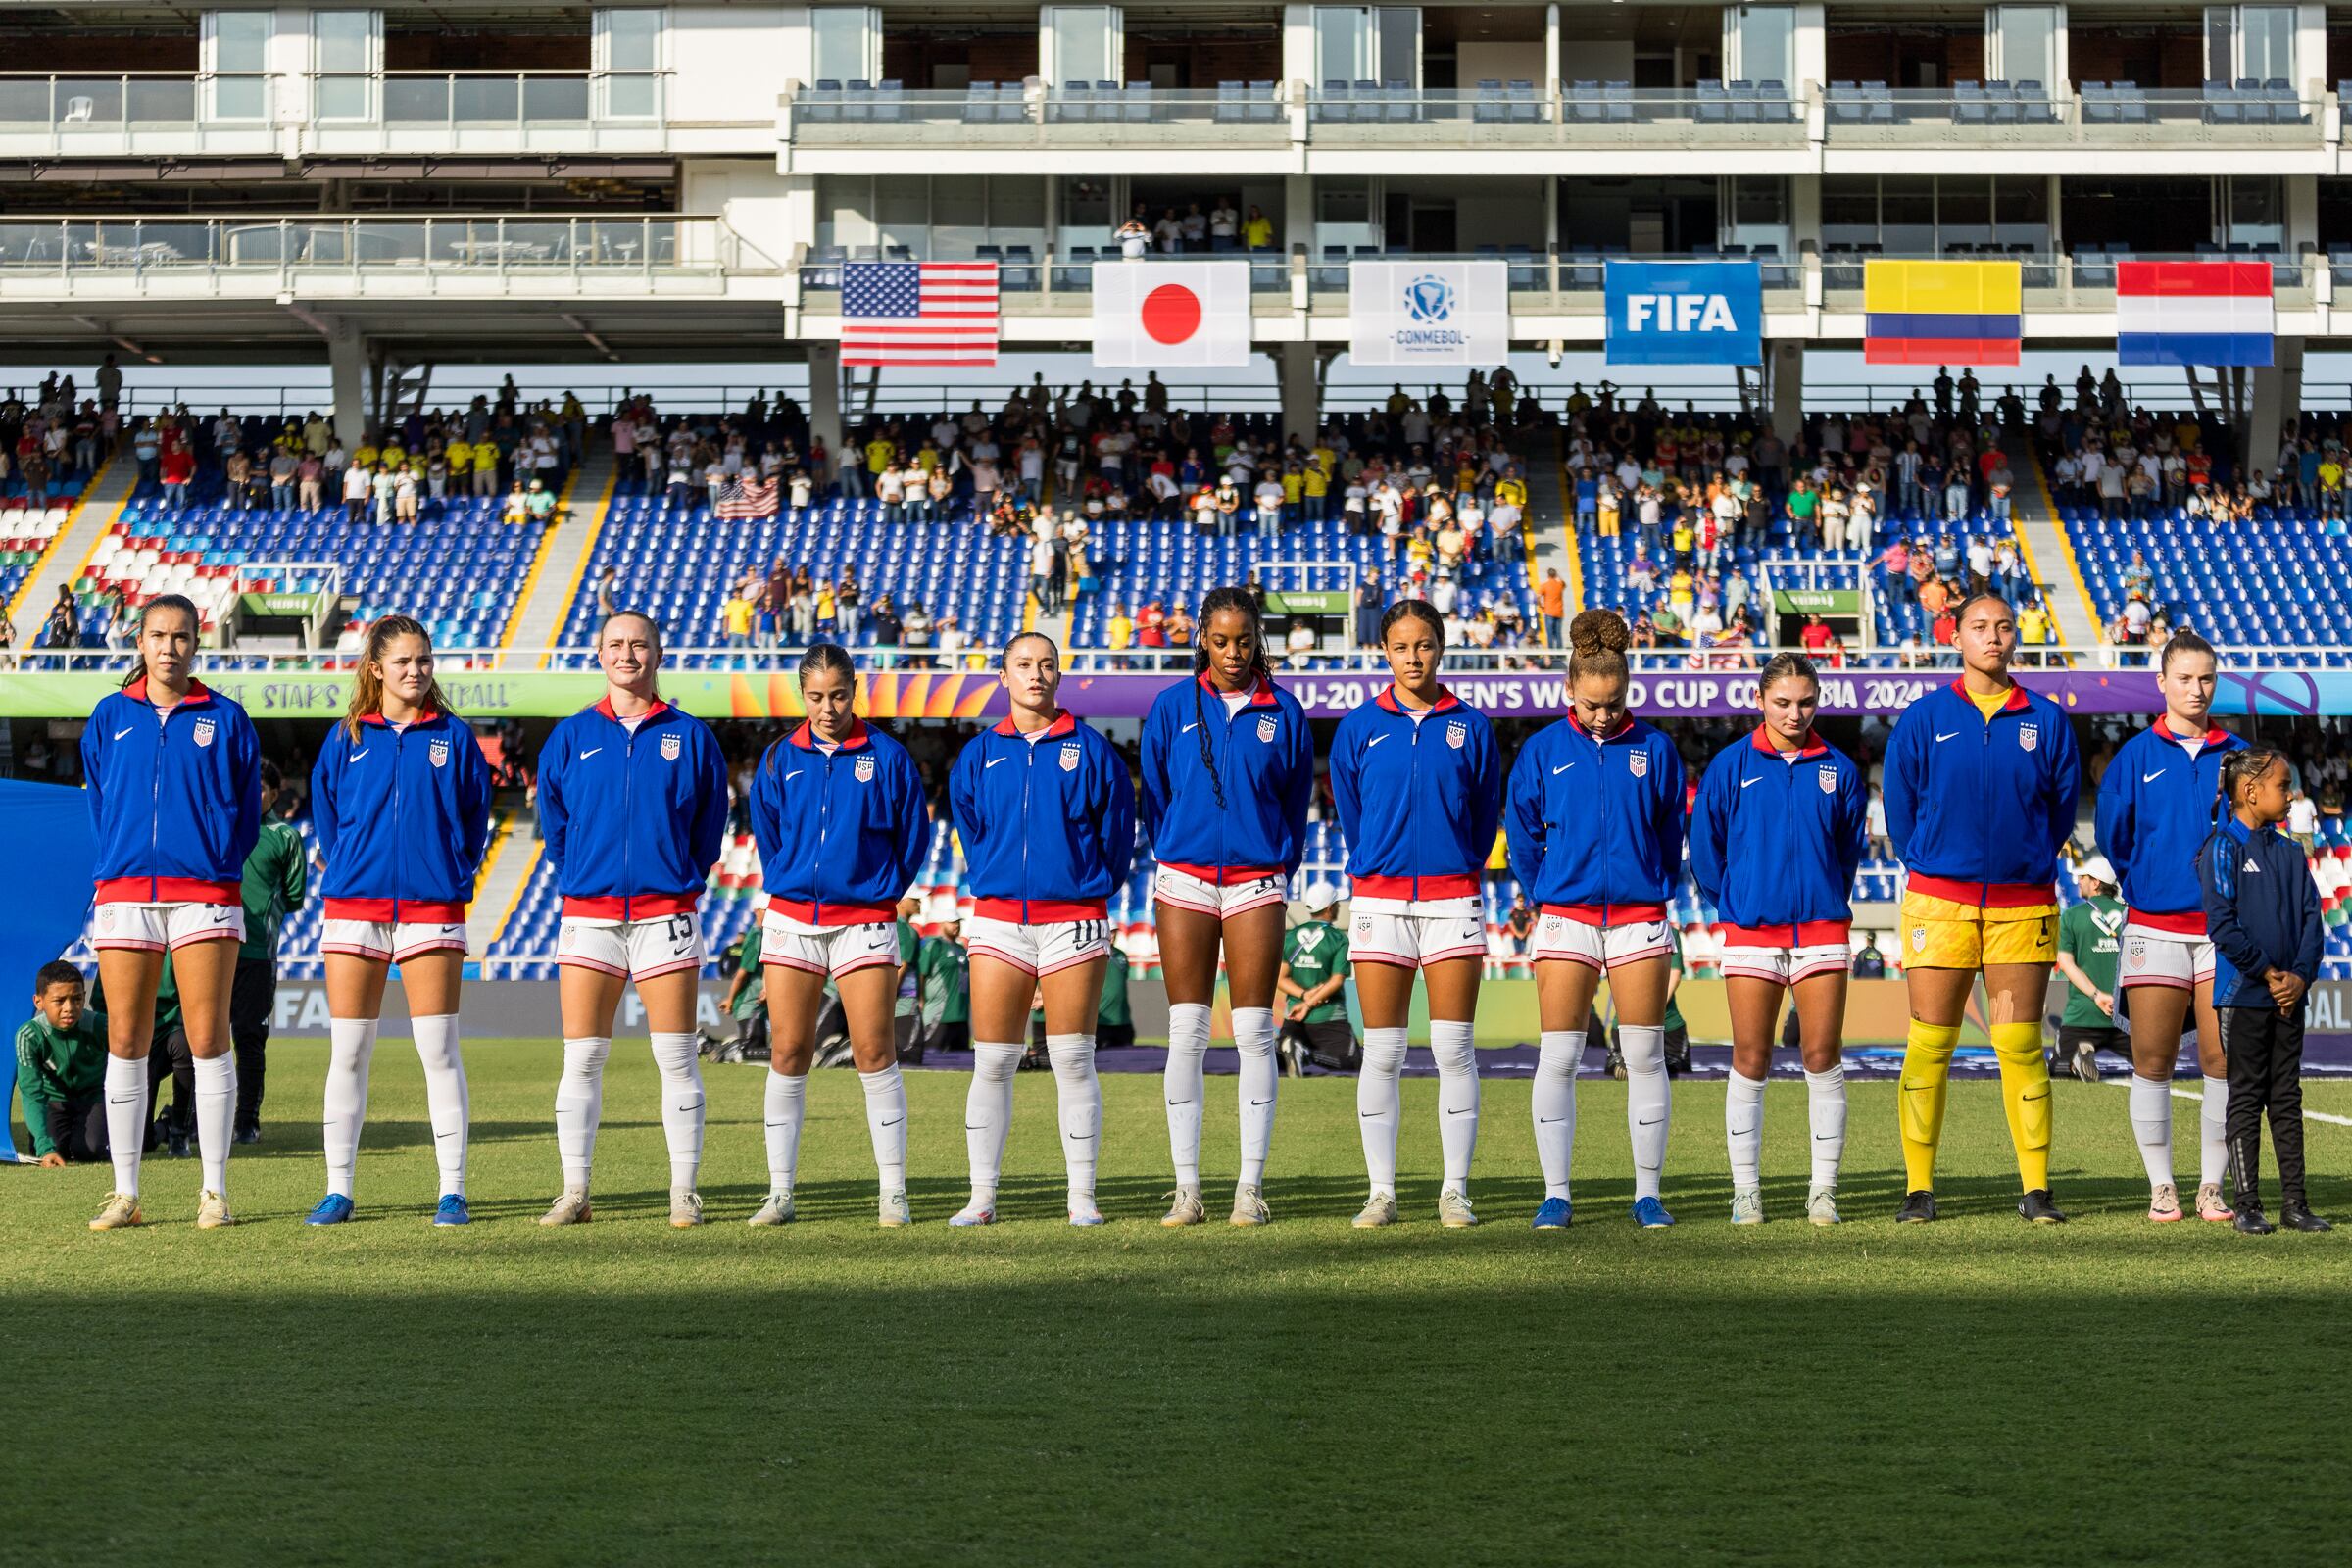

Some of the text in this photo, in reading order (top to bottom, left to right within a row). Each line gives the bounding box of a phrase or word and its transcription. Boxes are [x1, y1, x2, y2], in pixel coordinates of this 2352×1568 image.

[1627, 294, 1739, 332] FIFA
[1396, 330, 1465, 345] CONMEBOL
[261, 684, 340, 709] STARS
[1295, 681, 1364, 710] U-20
[1654, 679, 1720, 710] CUP
[196, 723, 214, 735] USA
[1260, 720, 1275, 732] USA
[1449, 727, 1465, 738] USA
[2021, 729, 2036, 740] USA
[662, 739, 679, 750] USA
[430, 746, 447, 757] USA
[1061, 749, 1079, 760] USA
[857, 760, 873, 771] USA
[1630, 756, 1646, 766] USA
[1820, 770, 1837, 782] USA
[1357, 921, 1371, 932] USA
[1546, 921, 1561, 932] USA
[1912, 929, 1926, 940] USA
[2131, 947, 2144, 956] USA
